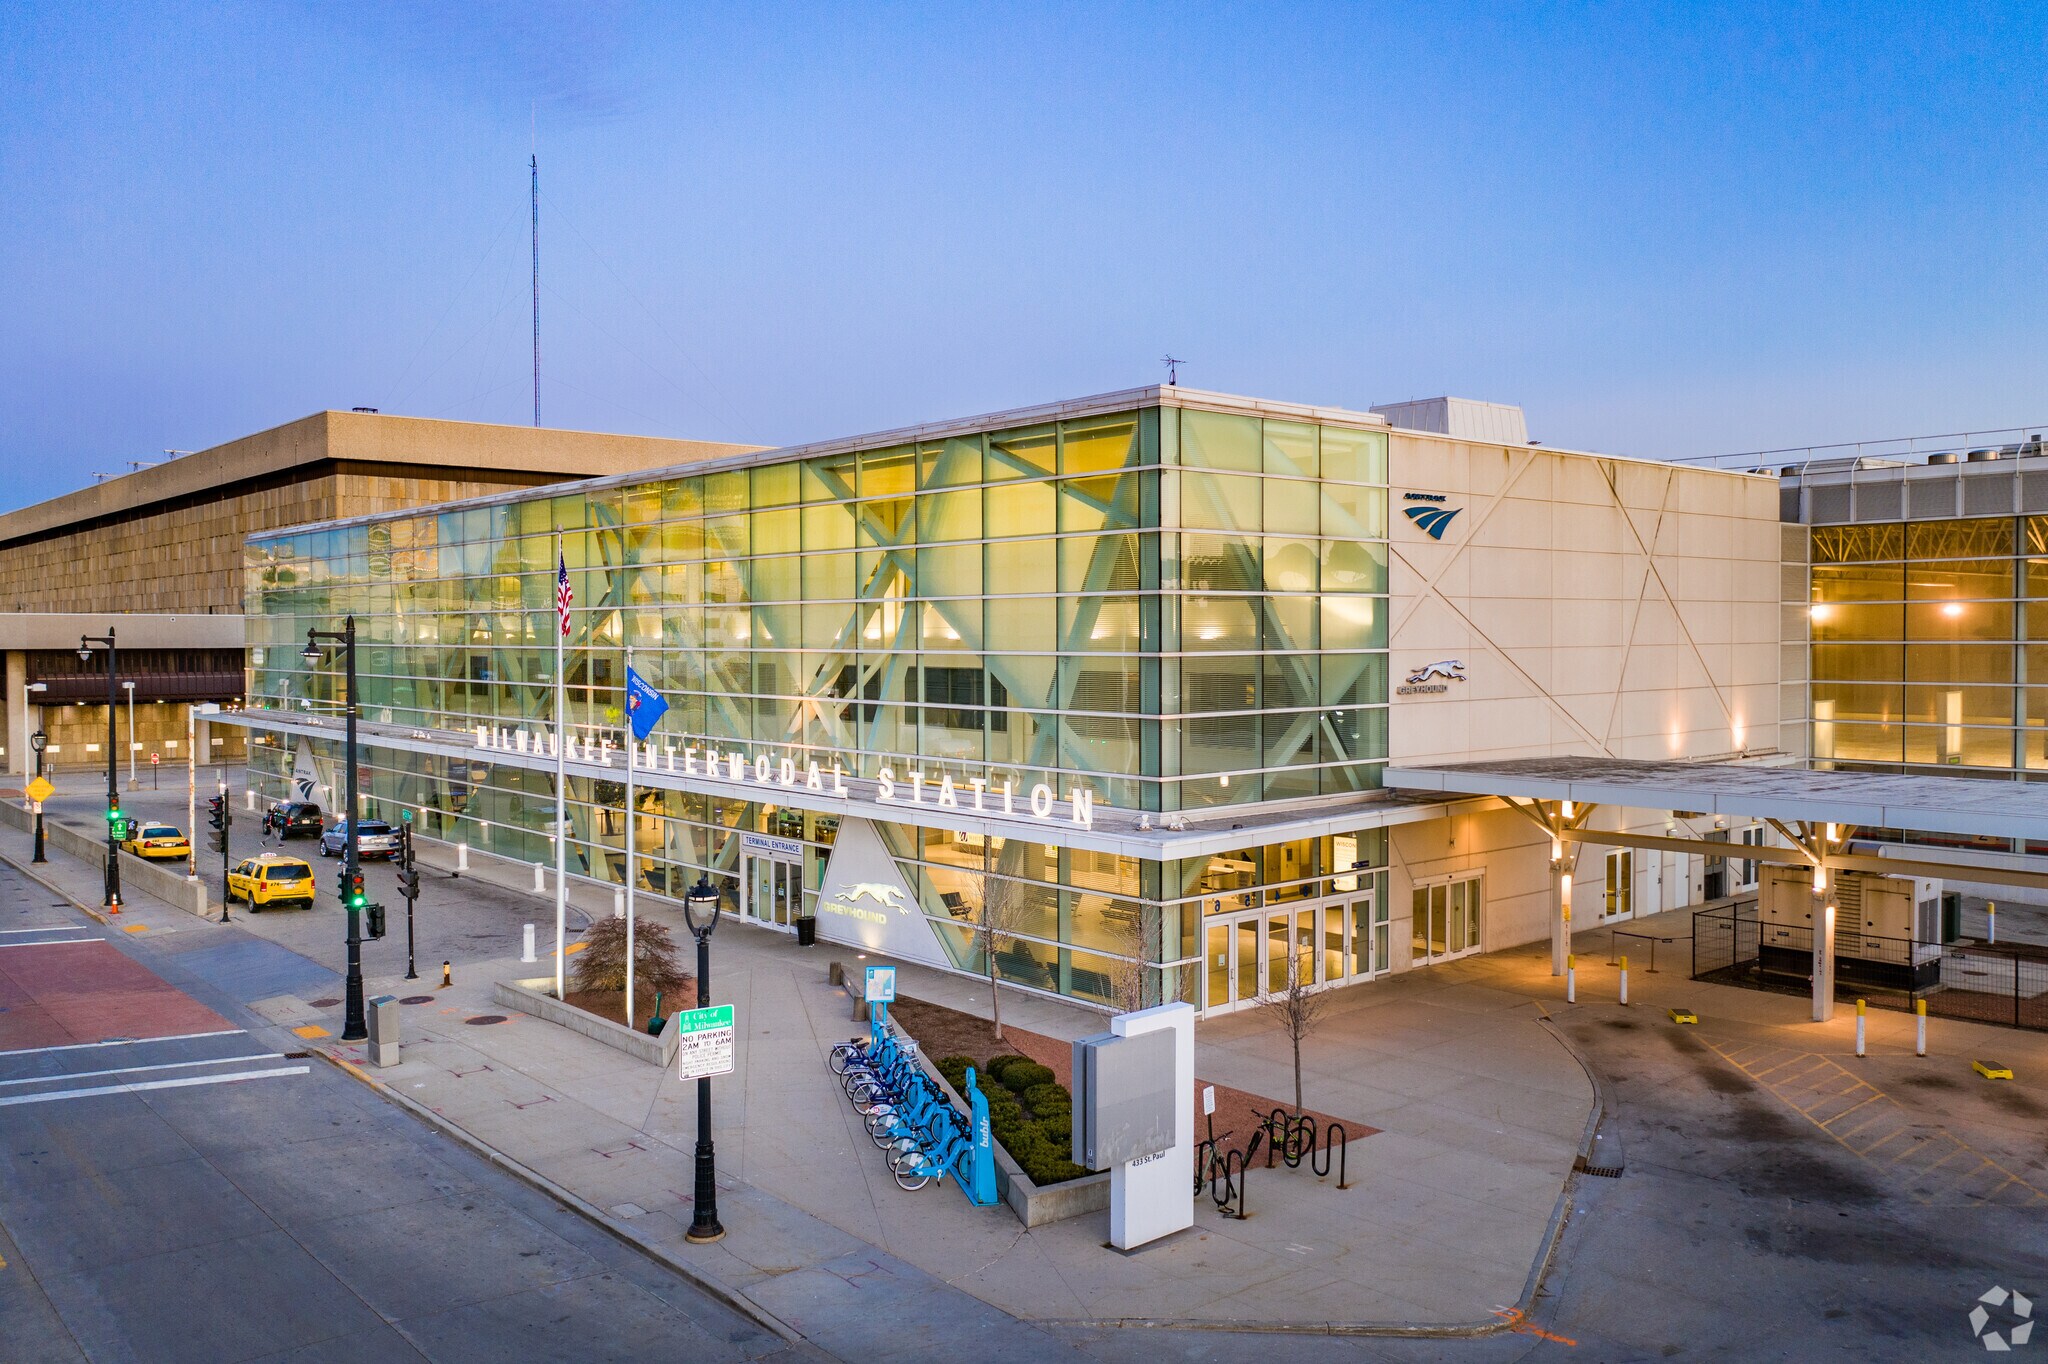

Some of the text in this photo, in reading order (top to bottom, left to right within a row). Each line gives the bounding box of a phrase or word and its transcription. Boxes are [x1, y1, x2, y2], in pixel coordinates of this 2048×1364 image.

[1399, 685, 1448, 694] GREYHOUND
[477, 725, 1093, 824] MILWAUKEE INTERMODAL STATION
[746, 836, 800, 853] TERMINAL ENTRANCE
[823, 901, 887, 925] GREYHOUND
[693, 1009, 718, 1021] City of
[694, 1019, 732, 1031] Milwaukee
[683, 1029, 732, 1043] NO PARKING
[683, 1042, 699, 1051] 2AM
[715, 1037, 732, 1046] 6AM
[979, 1116, 989, 1148] bublr
[1132, 1150, 1166, 1167] 433 St. Paul
